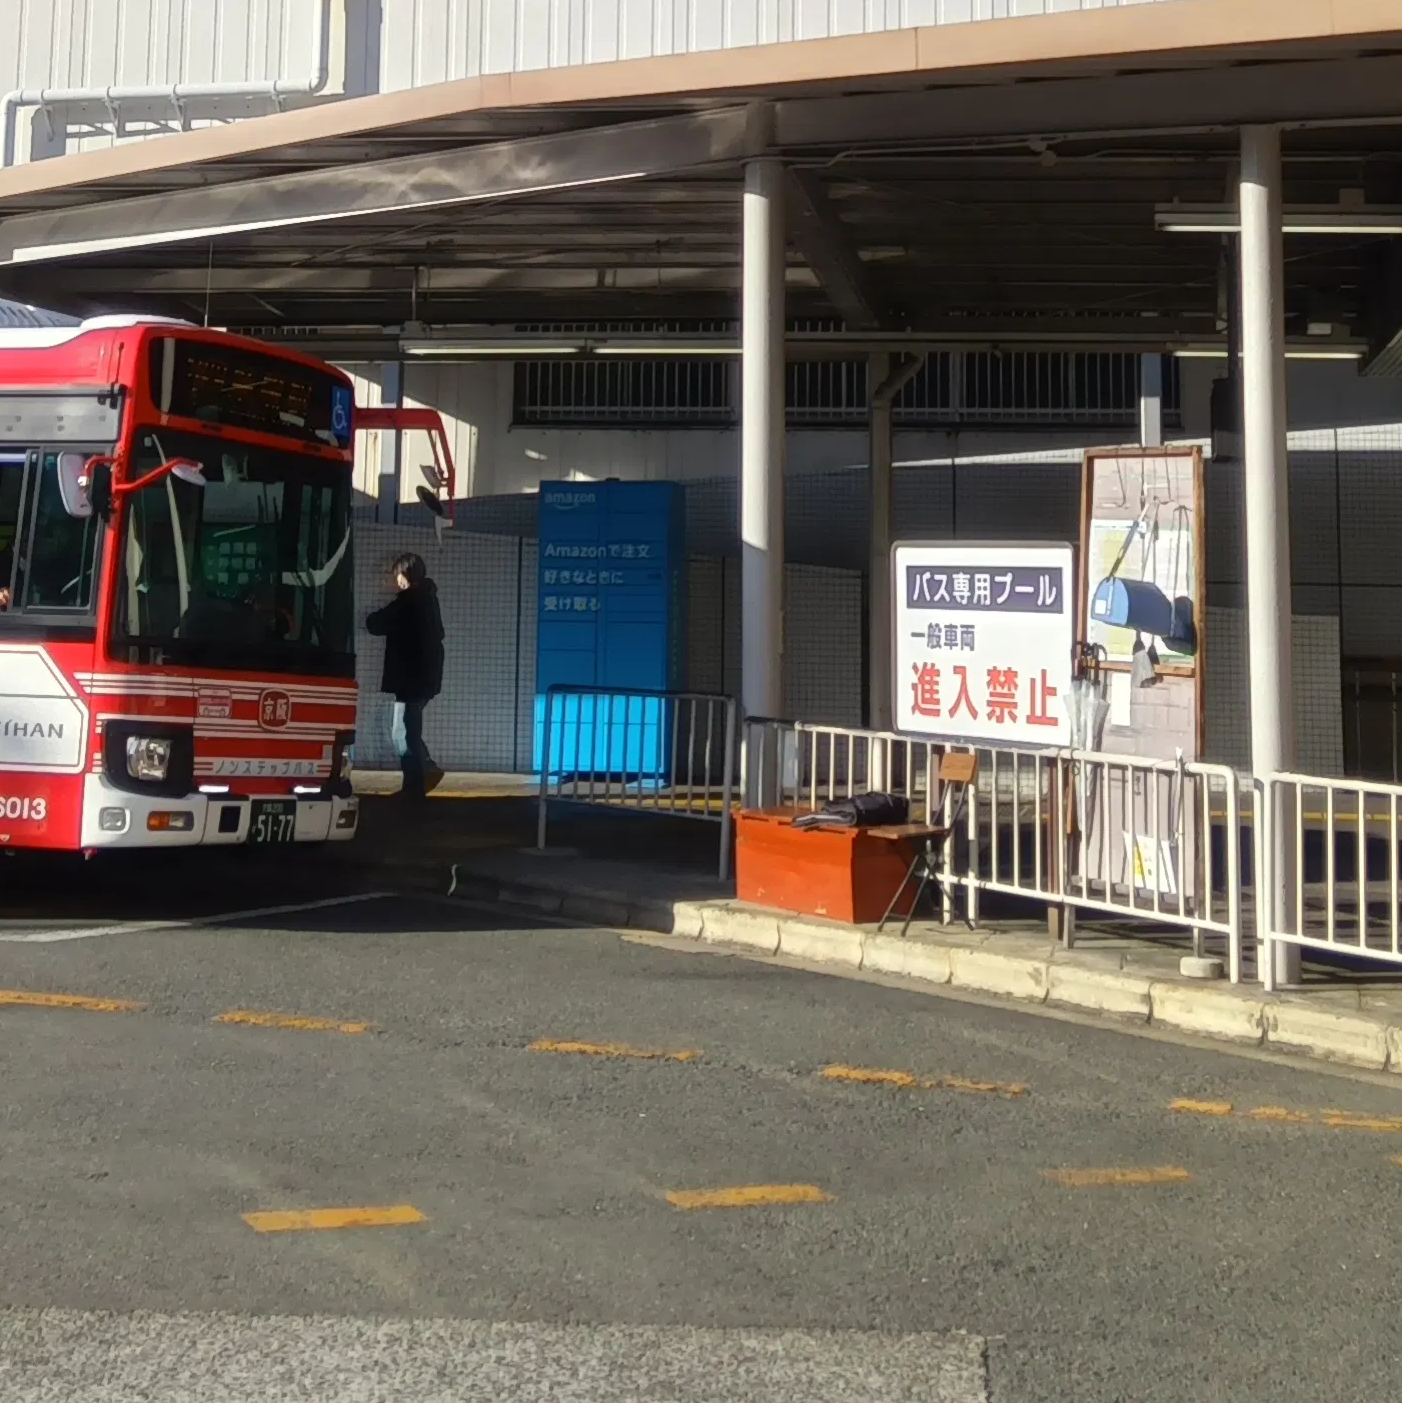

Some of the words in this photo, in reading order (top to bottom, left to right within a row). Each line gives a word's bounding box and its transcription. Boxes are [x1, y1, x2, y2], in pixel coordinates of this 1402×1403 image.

[544, 492, 596, 504] amazon
[544, 542, 651, 558] Amazonで注文
[913, 571, 1057, 607] バス専用プール
[544, 596, 600, 611] 受け取る
[911, 622, 976, 652] 一般車両
[911, 661, 1059, 727] 進入禁止
[264, 698, 288, 721] 京阪
[215, 760, 317, 775] ノンステップバス
